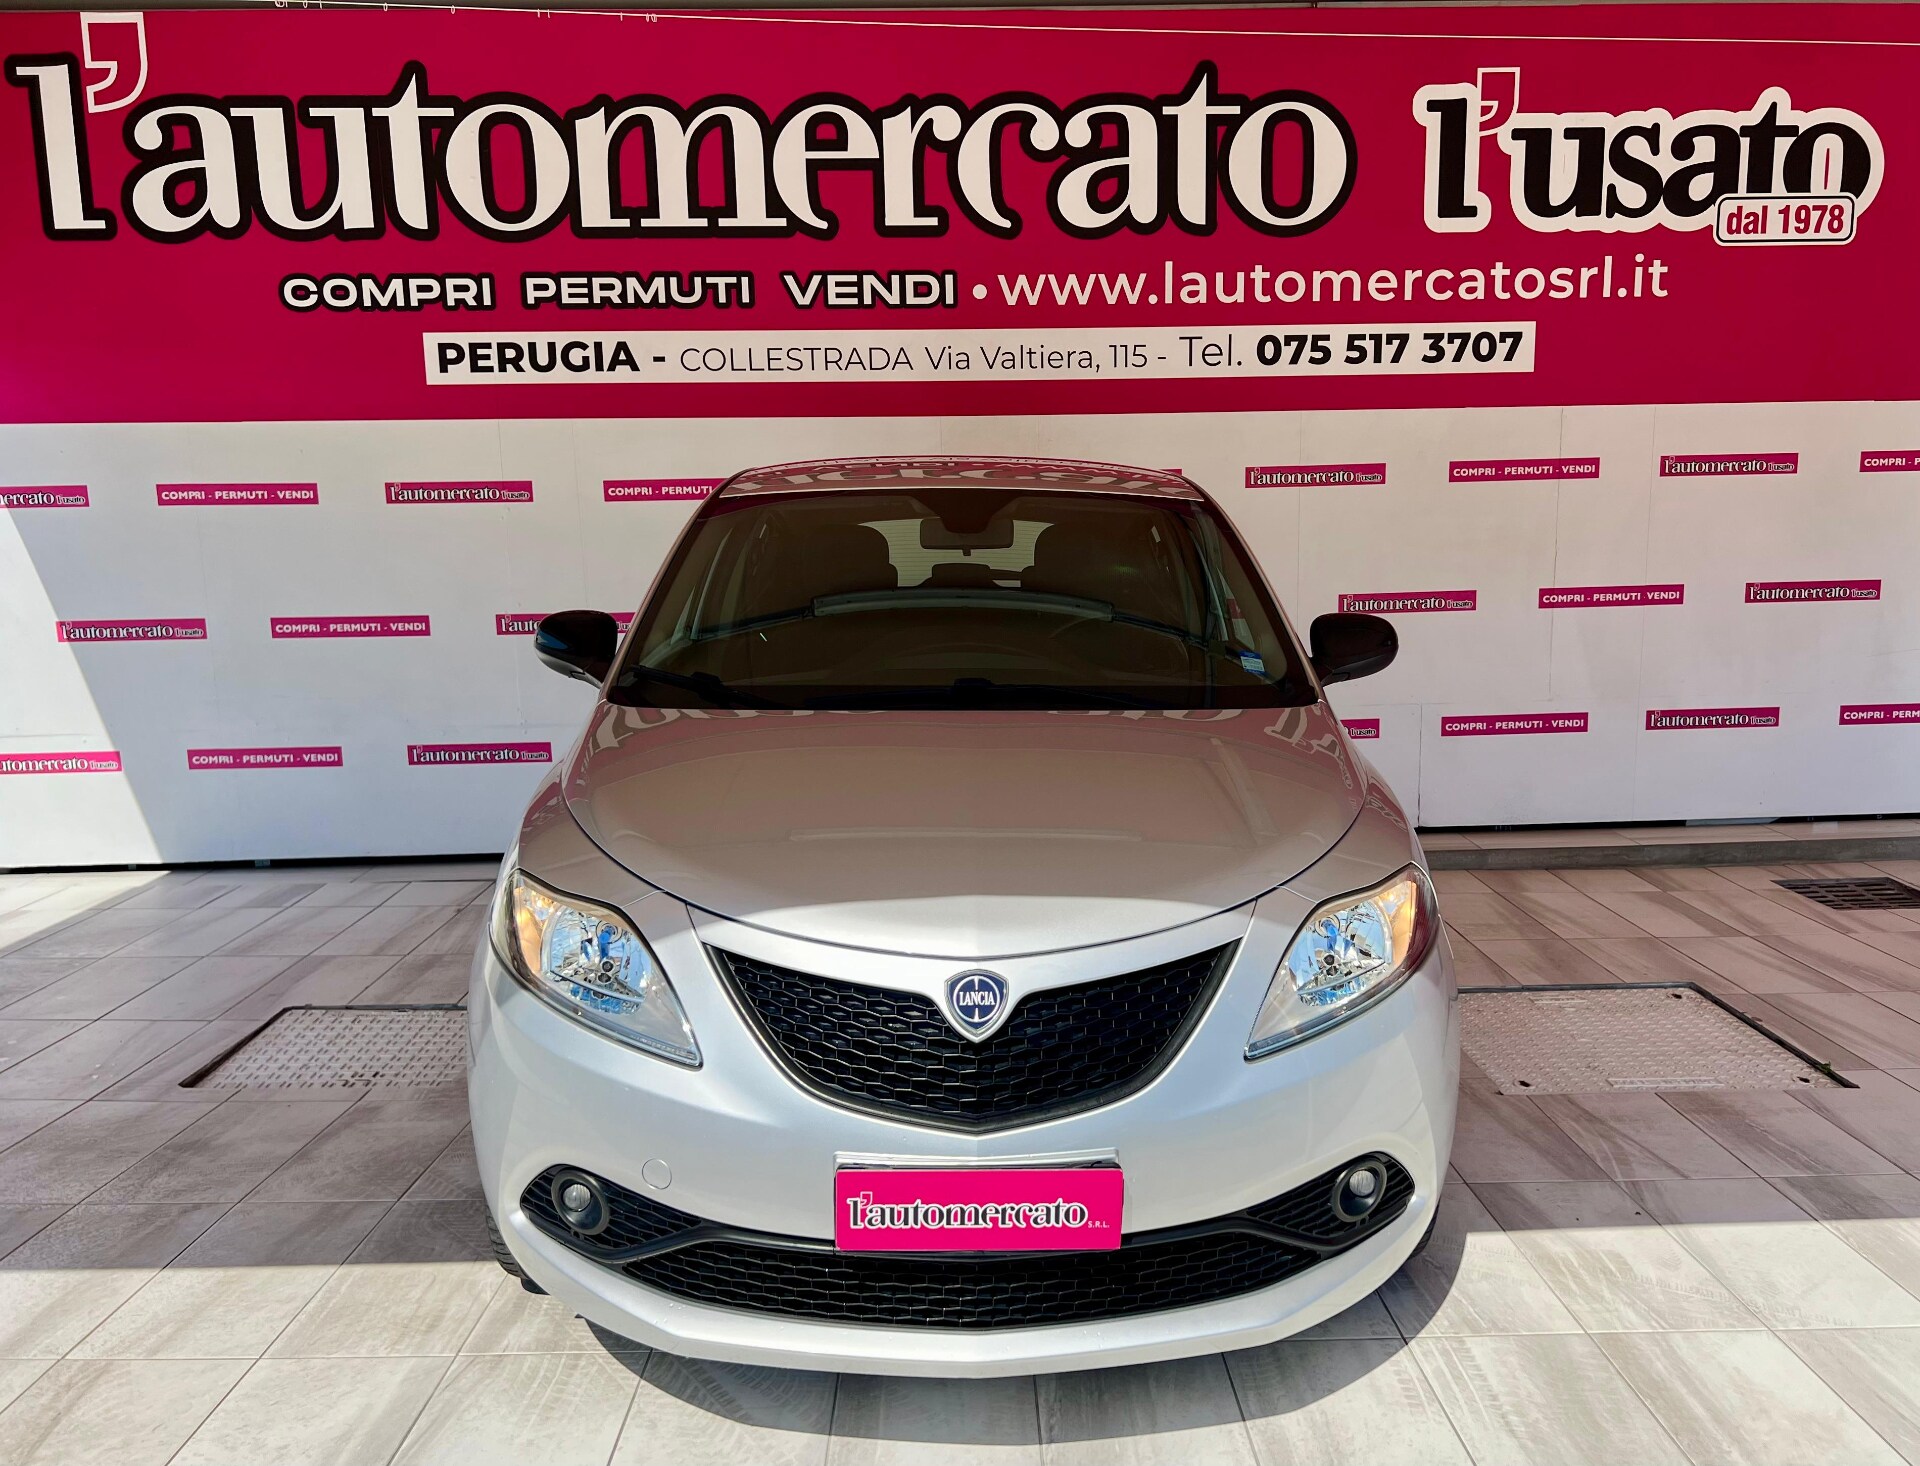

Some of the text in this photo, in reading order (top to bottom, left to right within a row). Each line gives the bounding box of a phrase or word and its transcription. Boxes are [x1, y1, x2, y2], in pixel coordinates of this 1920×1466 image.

[5, 12, 1357, 241] l'automercato
[1413, 67, 1884, 232] l'usato
[1726, 203, 1844, 236] dal 1978
[281, 254, 1669, 310] COMPRI PERMUTI VENDI www.lautomercatosrl.it
[437, 330, 1524, 375] PERUGIA COLLESTRADA Via Valtiera, 115 Tel. 075 517 3707
[1453, 464, 1596, 477] COMPRI PERMUTI VENDI
[1664, 455, 1767, 474] l'automercato
[1864, 457, 1906, 467] COMPRI
[1250, 467, 1354, 486] l'automercato
[161, 489, 314, 500] COMPRI PERMUTI VENDI
[390, 482, 500, 501] l'automercato
[607, 485, 713, 496] COMPRI PERMUTI
[1542, 590, 1680, 604] COMPRI PERMUTI VENDI
[1749, 582, 1850, 600] l'automercato
[1343, 595, 1445, 613] l'automercato
[61, 621, 174, 640] l'automercato
[275, 622, 426, 634] COMPRI PERMUTI VENDI
[1650, 710, 1749, 728] l'automercato
[1843, 710, 1920, 720] COMPRI PERM
[1445, 719, 1585, 731] COMPRI PERMUTI VENDI
[192, 752, 338, 765] COMPRI PERMUTI VENDI
[412, 744, 520, 763] l'automercato
[959, 990, 996, 1006] LANCIA
[846, 1191, 1110, 1230] l'automercato S.R.L.
